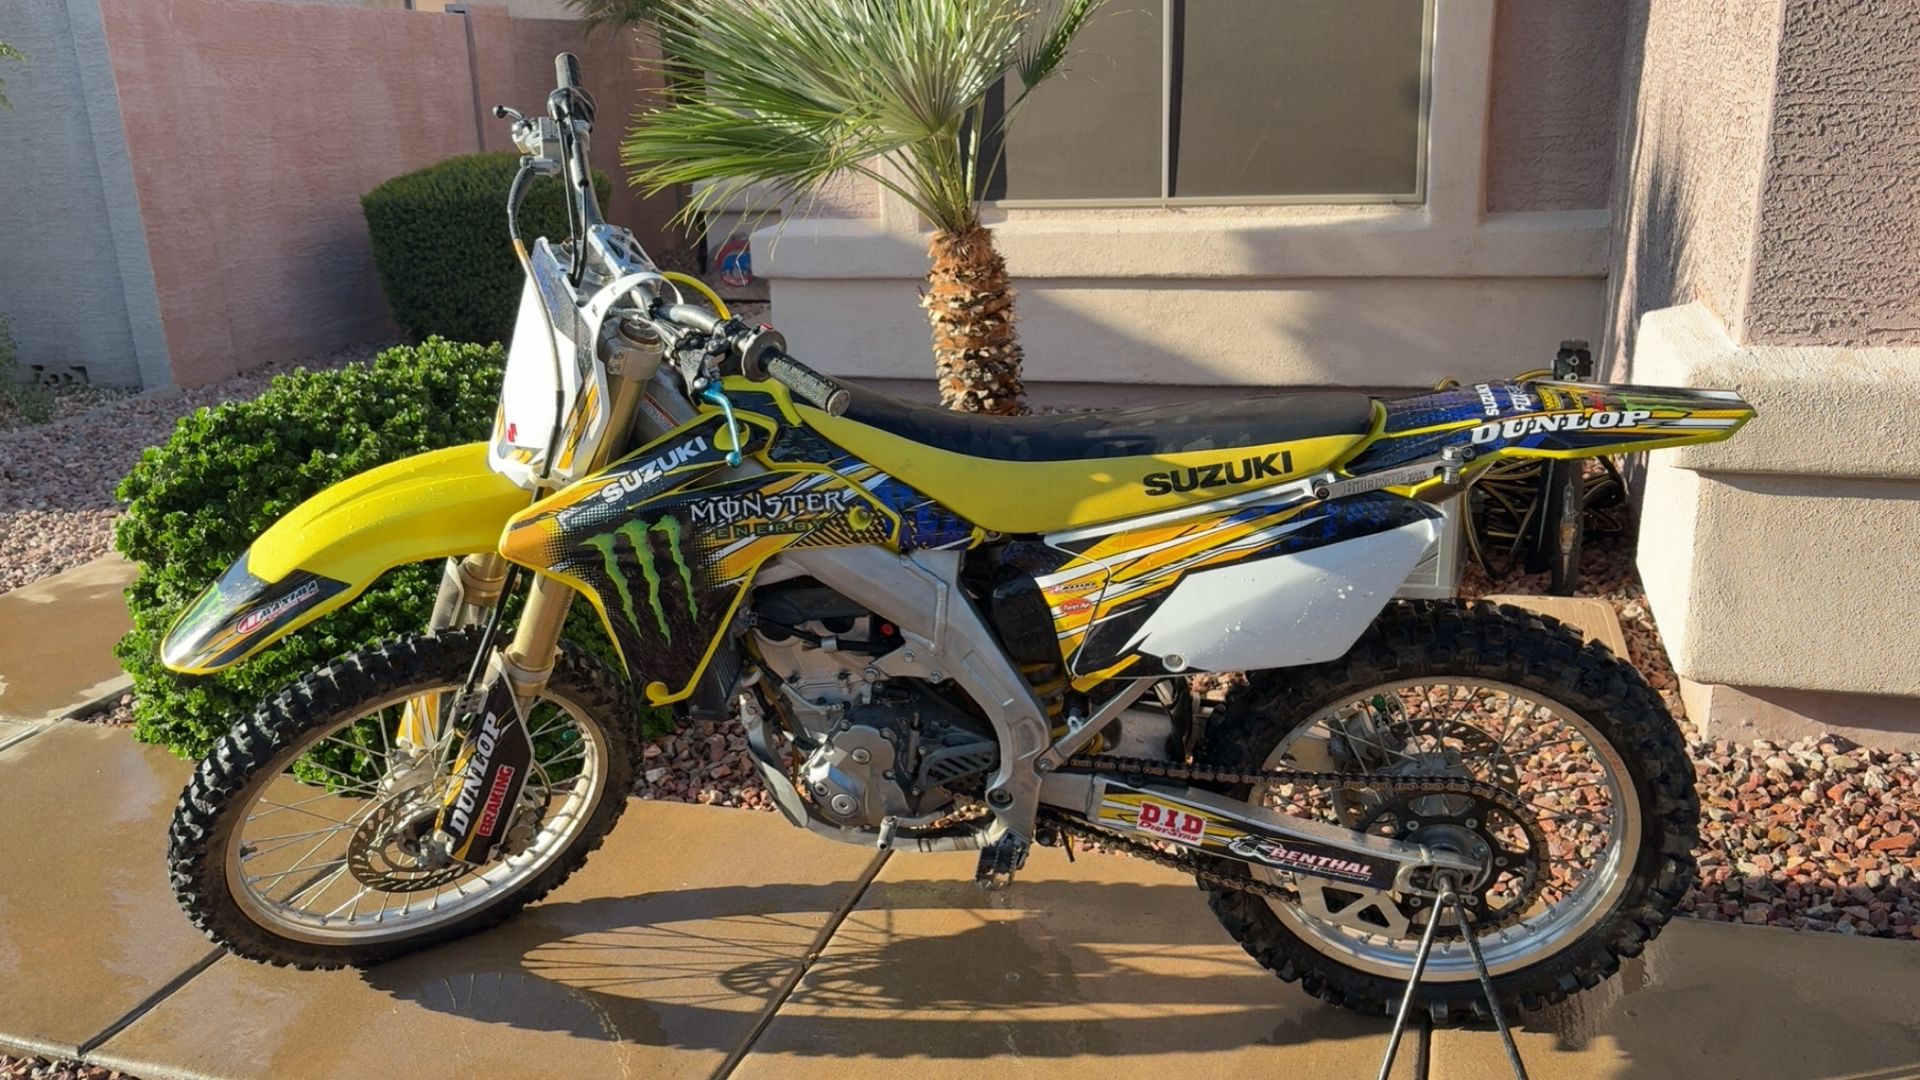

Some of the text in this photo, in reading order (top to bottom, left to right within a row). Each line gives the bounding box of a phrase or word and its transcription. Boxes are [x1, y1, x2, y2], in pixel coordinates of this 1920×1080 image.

[1475, 383, 1500, 416] SUZUKI
[1471, 410, 1650, 444] DUNLOP
[601, 436, 709, 504] SUZUKI
[1143, 450, 1293, 496] SUZUKI
[690, 491, 846, 525] MONSTER
[716, 519, 824, 539] ENERGY
[450, 711, 501, 837] DUNLOP
[478, 764, 515, 836] BRAKING
[1268, 847, 1373, 875] RENTHAL
